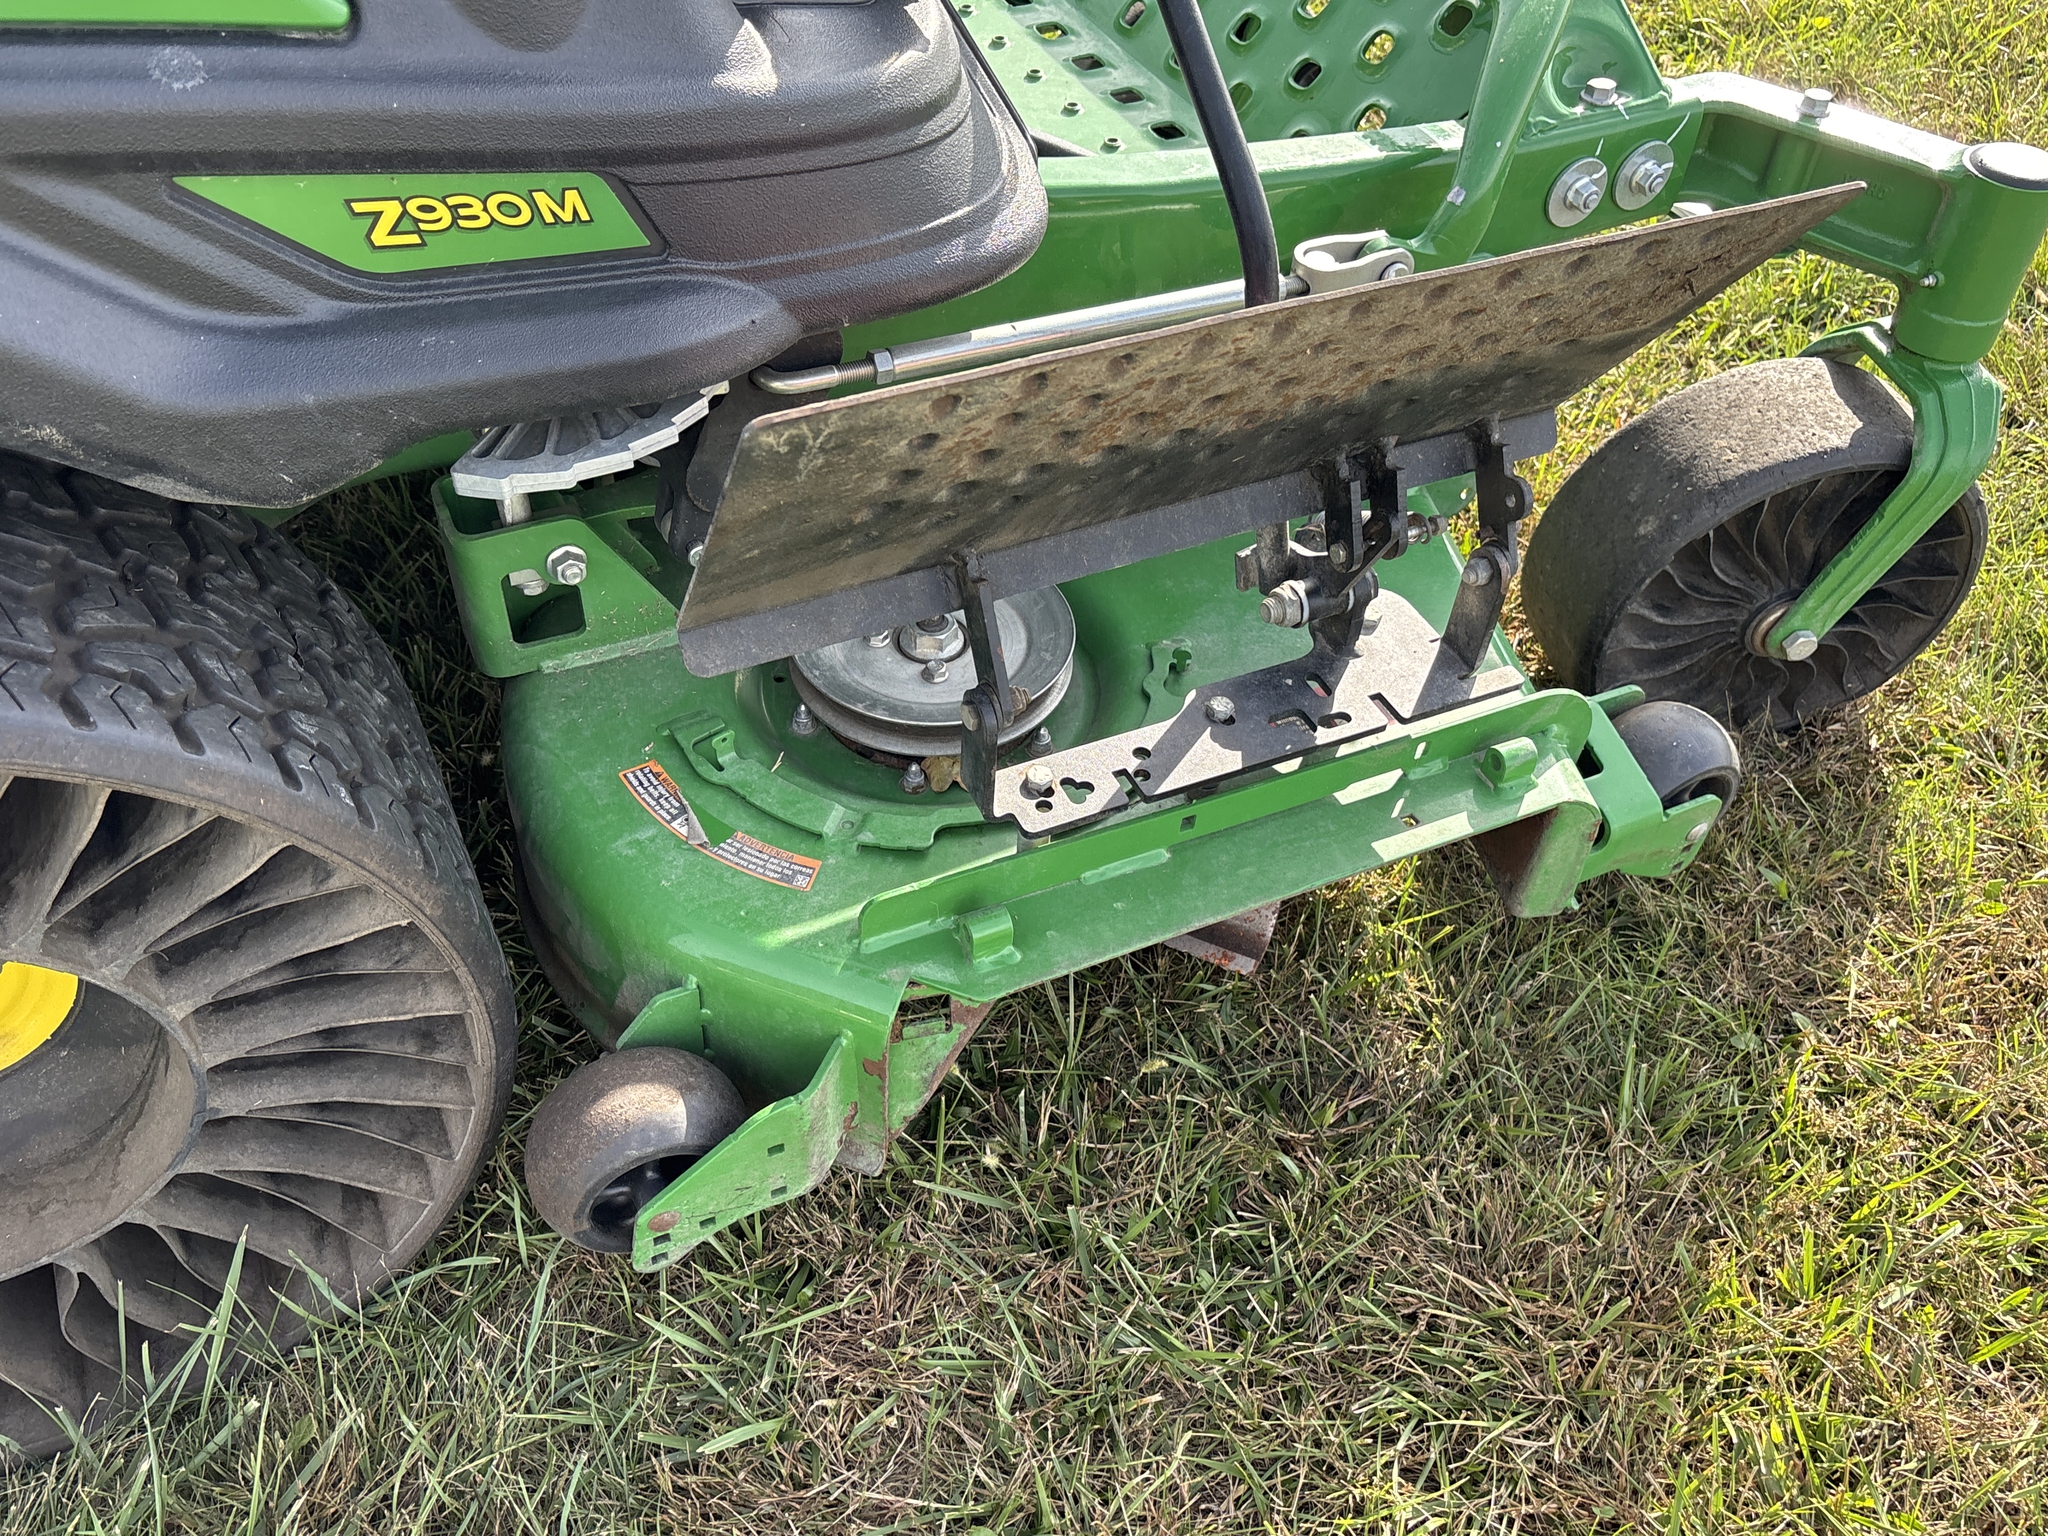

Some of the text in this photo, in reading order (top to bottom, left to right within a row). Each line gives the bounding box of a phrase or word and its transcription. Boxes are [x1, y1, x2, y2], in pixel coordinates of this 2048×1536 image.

[347, 188, 593, 248] Z930M
[635, 770, 650, 787] rotating
[658, 796, 671, 809] keep
[636, 786, 646, 794] and
[641, 793, 657, 807] guards
[646, 773, 660, 785] avoid
[656, 785, 670, 797] injury
[668, 796, 680, 807] from
[716, 850, 749, 866] protectores
[739, 835, 795, 861] ADVERTENCIA
[742, 845, 769, 860] lesionado
[780, 859, 790, 867] las
[790, 864, 813, 874] correas
[739, 852, 766, 865] mantener
[766, 862, 782, 872] todos
